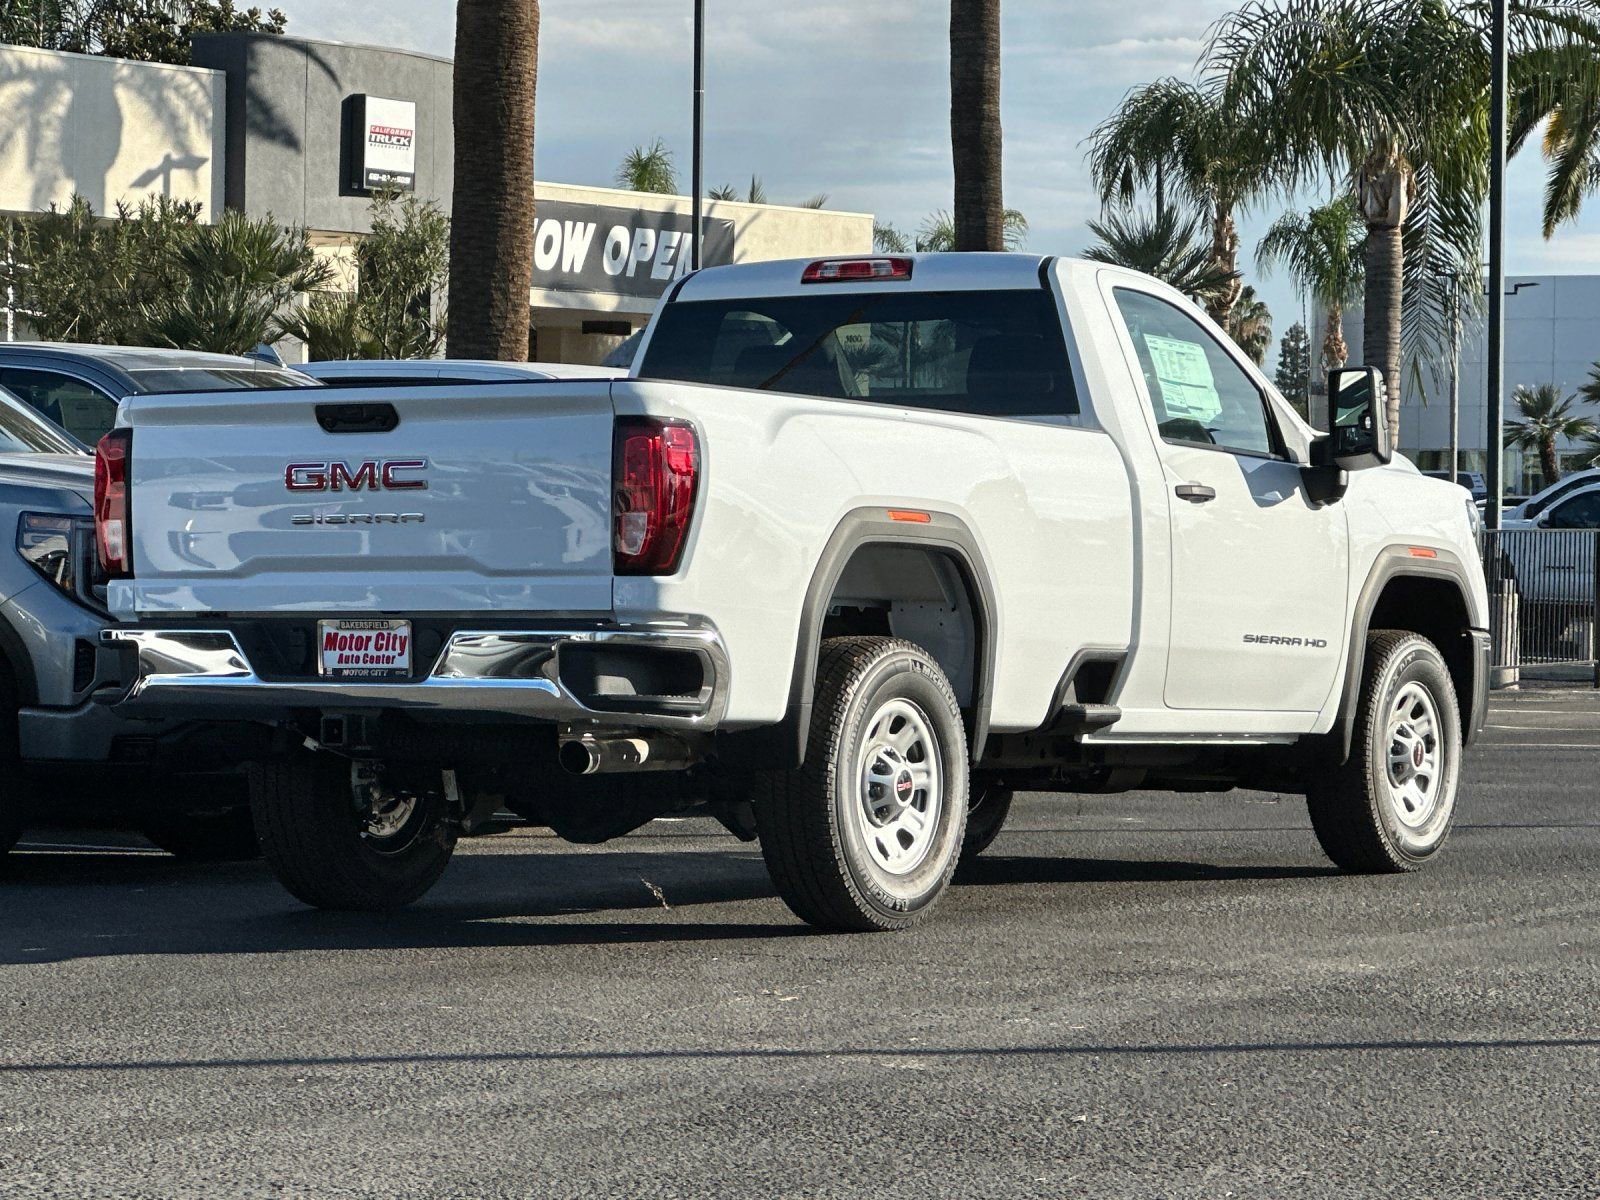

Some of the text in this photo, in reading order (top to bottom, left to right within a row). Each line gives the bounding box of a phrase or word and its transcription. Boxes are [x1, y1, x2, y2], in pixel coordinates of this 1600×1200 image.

[371, 126, 413, 136] CALIFORNIA
[370, 134, 410, 146] TRUCK
[534, 218, 596, 273] OW
[285, 460, 428, 491] GMC
[291, 512, 426, 525] SIERRA
[340, 621, 389, 629] BAKERSFIELD
[324, 632, 408, 656] Motor City
[1243, 634, 1328, 648] SIERRA HD
[337, 653, 396, 665] Auto Center
[341, 669, 369, 677] MOTOR
